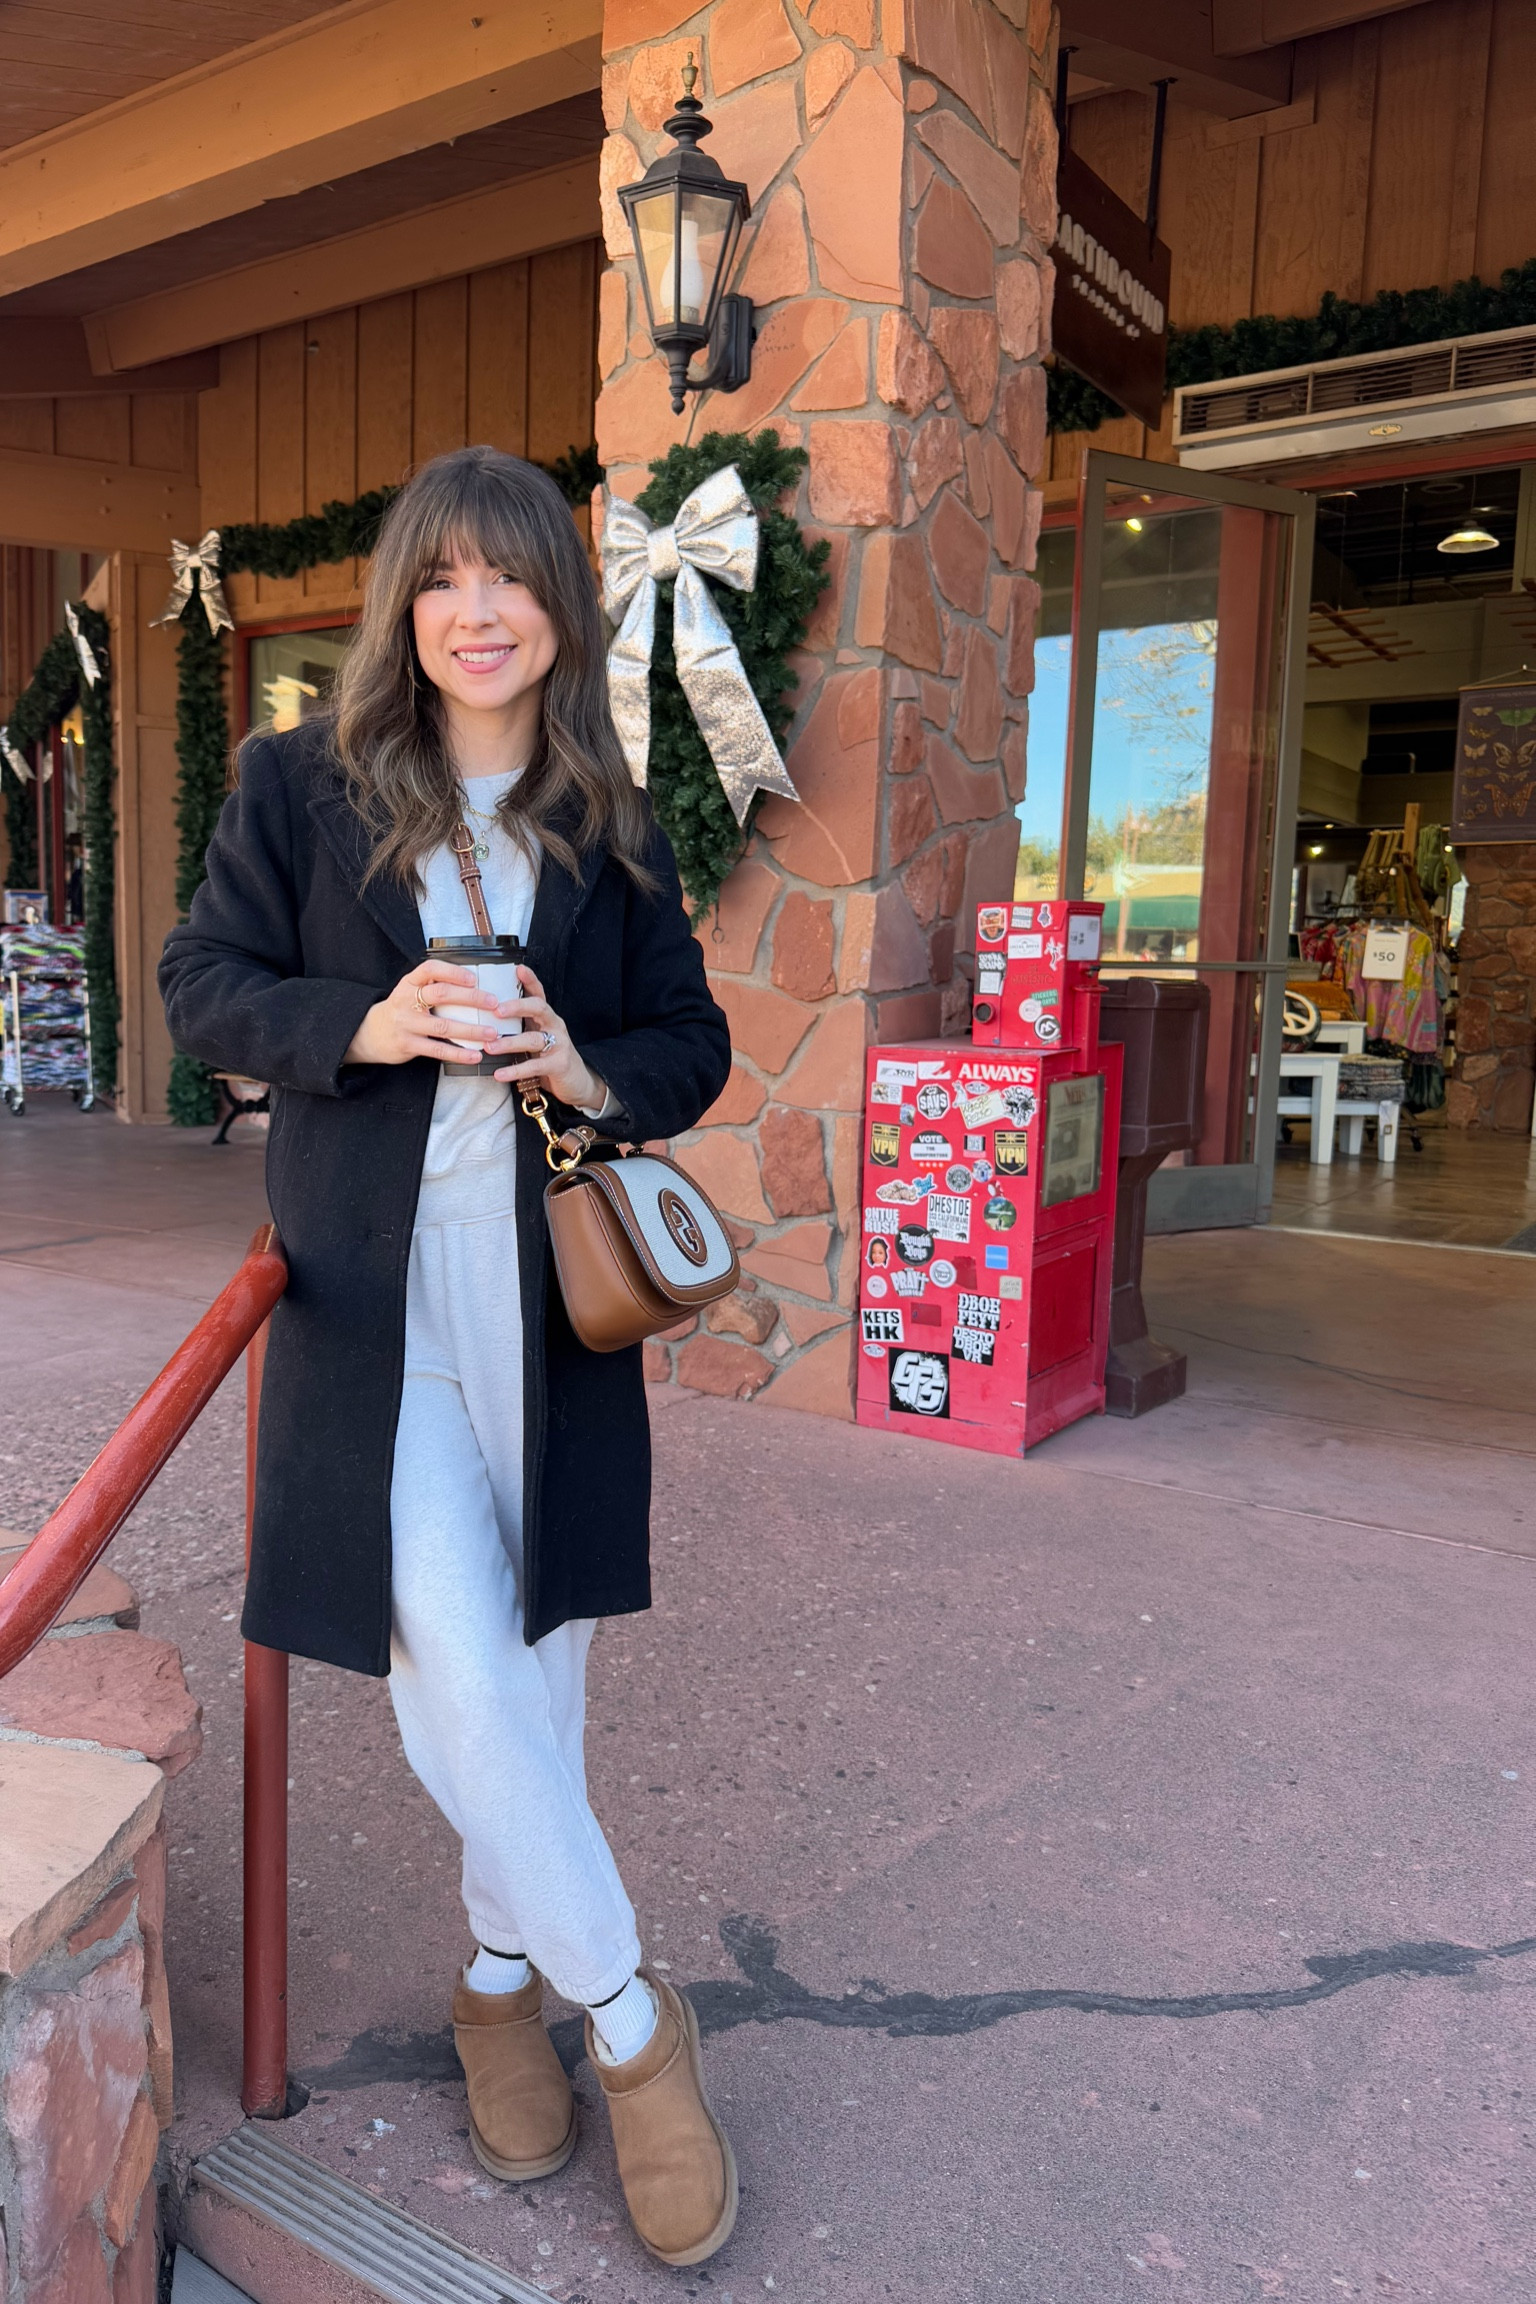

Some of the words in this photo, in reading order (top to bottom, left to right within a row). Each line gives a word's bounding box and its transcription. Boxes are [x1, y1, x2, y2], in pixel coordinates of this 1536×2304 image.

[958, 1063, 1037, 1083] ALWAYS
[874, 1138, 897, 1156] YPN
[918, 1135, 943, 1143] VOTE
[998, 1147, 1025, 1164] YPN
[863, 1310, 900, 1324] KETS
[865, 1325, 899, 1340] HK
